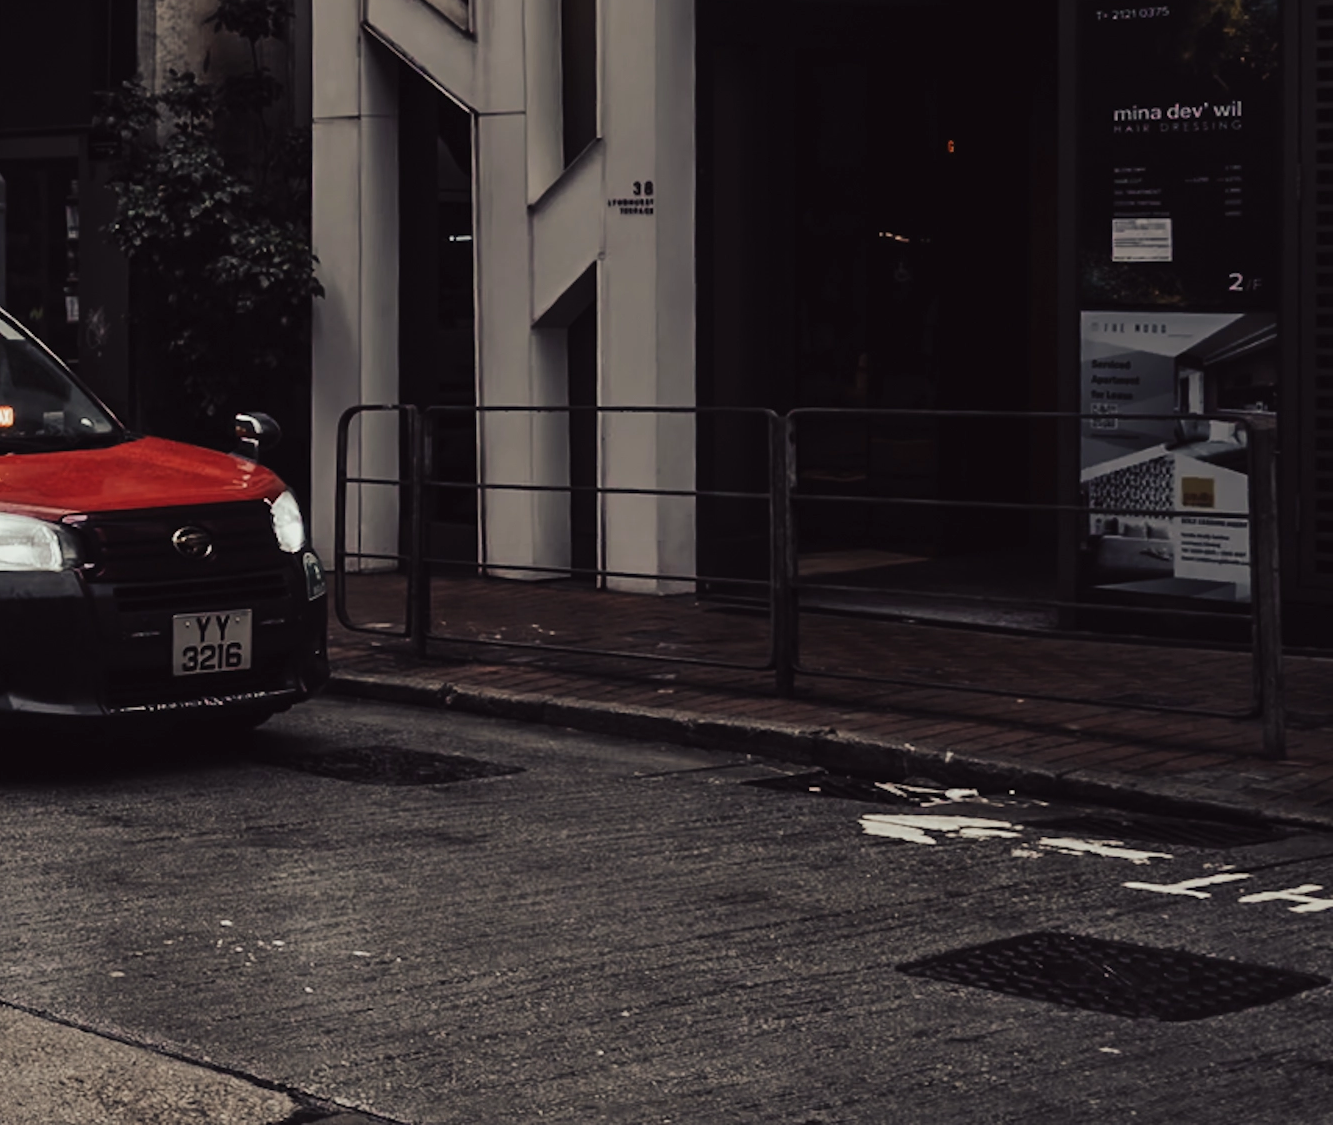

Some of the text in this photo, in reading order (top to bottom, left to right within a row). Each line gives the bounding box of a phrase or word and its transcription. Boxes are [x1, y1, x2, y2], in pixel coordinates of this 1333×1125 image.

[1111, 9, 1137, 20] 2121
[1138, 6, 1171, 18] 0375
[1113, 105, 1163, 121] mina
[1213, 100, 1243, 117] wil
[1113, 120, 1243, 134] HAIR DRESSING
[633, 181, 654, 195] 38
[1229, 272, 1263, 292] 2/F
[1091, 375, 1140, 386] Apartment
[197, 615, 230, 642] YY
[183, 642, 242, 672] 3216
